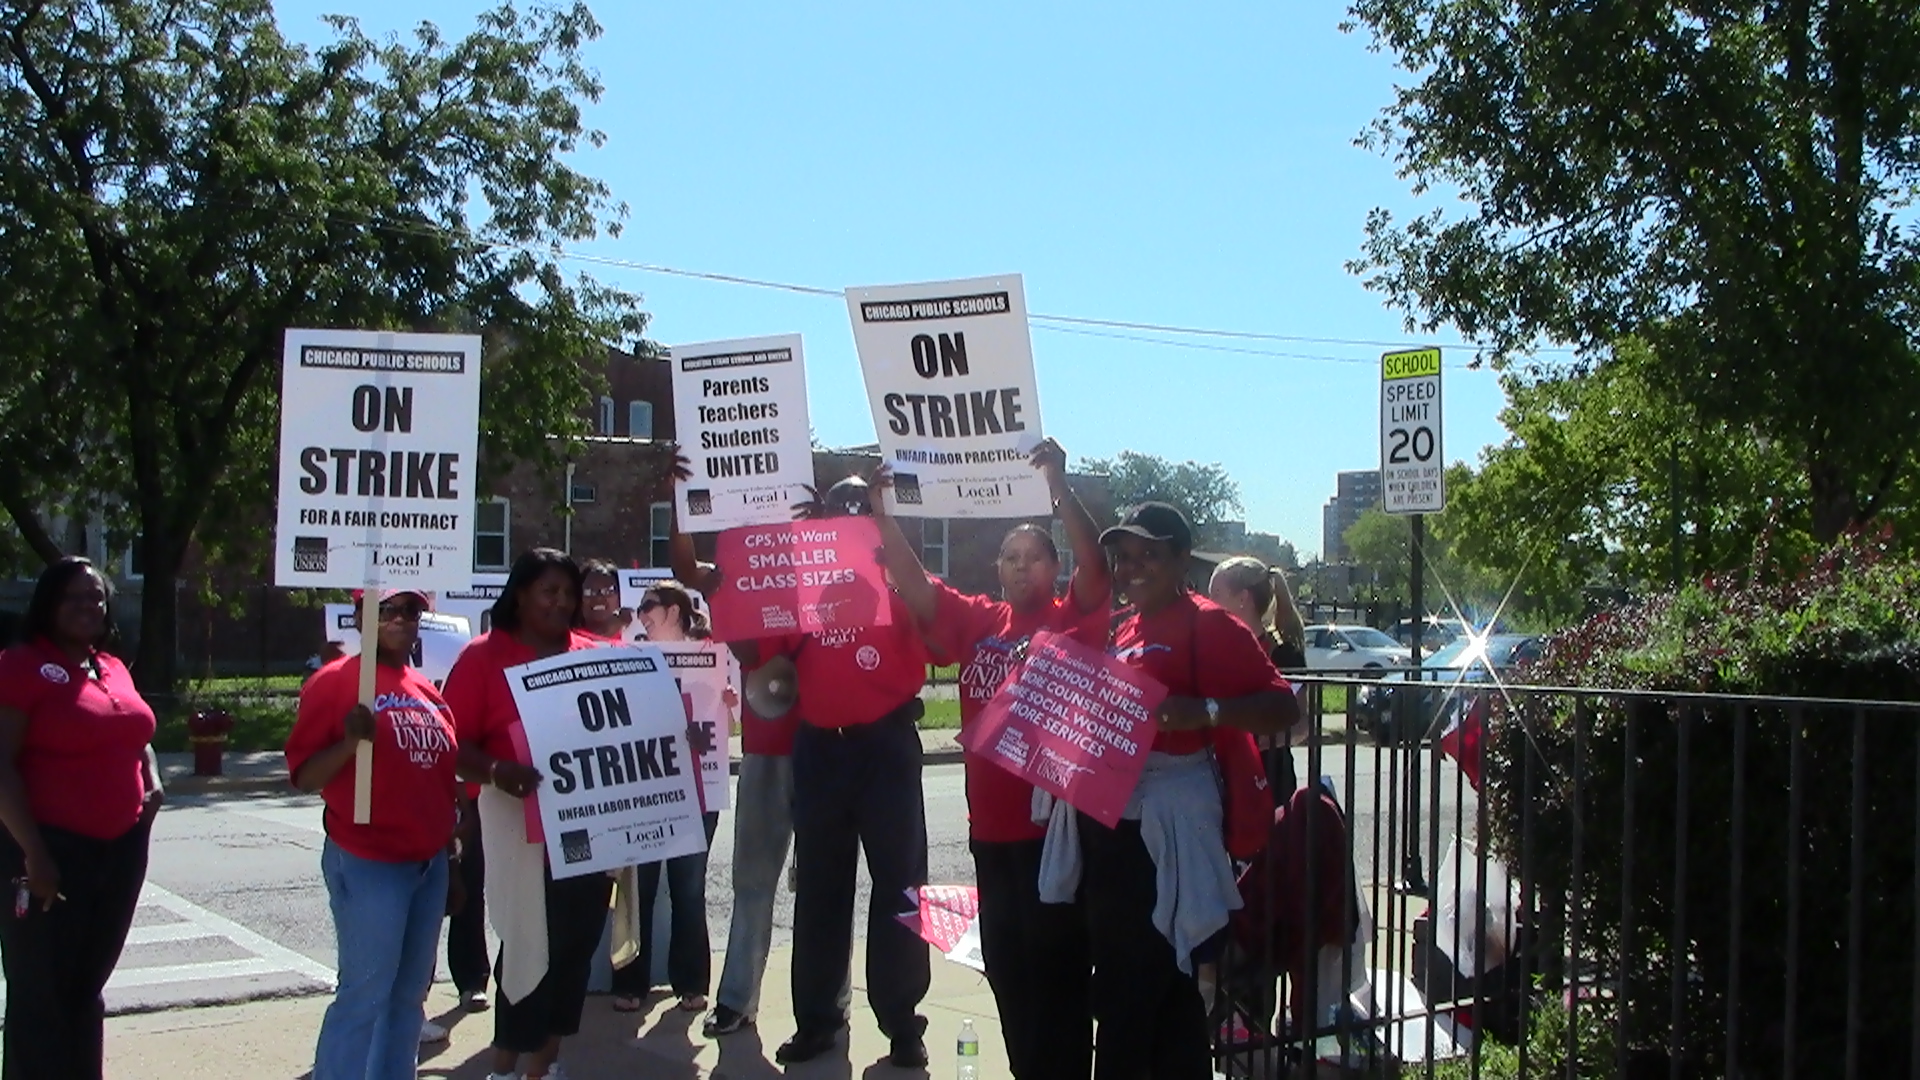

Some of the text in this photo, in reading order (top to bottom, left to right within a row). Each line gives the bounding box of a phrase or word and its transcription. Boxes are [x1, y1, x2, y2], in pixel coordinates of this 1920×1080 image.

[864, 296, 1006, 321] CHICAGO PUBLIC SCHOOLS
[304, 350, 461, 370] CHICAGO PUBLIC SCHOOLS
[911, 332, 970, 380] ON
[1386, 354, 1436, 375] SCHOOL
[703, 376, 769, 397] Parents
[1387, 382, 1435, 402] SPEED
[352, 384, 413, 433] ON
[698, 402, 778, 424] Teachers
[884, 388, 1026, 438] STRIKE
[1392, 404, 1429, 422] LIMIT
[700, 428, 779, 449] Students
[1389, 426, 1434, 464] 20
[706, 452, 779, 478] UNITED
[896, 449, 927, 464] UNFAIR
[930, 452, 963, 465] LABOR
[300, 447, 459, 500] STRIKE
[1386, 467, 1438, 480] ON SCHOOL DAYS
[743, 490, 788, 504] Local 1
[957, 483, 1012, 498] Local 1
[1389, 480, 1437, 492] WHEN CHILDREN
[1393, 493, 1433, 505] ARE PRESENT
[300, 508, 458, 530] FOR A FAIR CONTRACT
[384, 542, 420, 550] Federation
[744, 530, 838, 548] CPS, We Want
[294, 560, 328, 572] UNION
[372, 550, 434, 568] Local 1
[748, 548, 838, 568] SMALLER
[736, 568, 855, 592] CLASS SIZES
[676, 655, 714, 667] SCHOOLS
[526, 672, 574, 688] CHICAGO
[574, 666, 610, 680] PUBLIC
[610, 660, 654, 674] SCHOOLS
[1097, 667, 1144, 698] Deserve:
[1049, 662, 1094, 694] SCHOOL
[1098, 686, 1149, 722] NURSES
[577, 688, 632, 732] ON
[1046, 681, 1134, 733] COUNSELORS
[1008, 700, 1106, 758] MORE SERVICES
[1028, 692, 1070, 720] SOCIAL
[1073, 712, 1138, 756] WORKERS
[394, 726, 450, 752] UNION
[550, 736, 681, 794] STRIKE
[1036, 760, 1070, 790] UNION
[558, 790, 686, 822] UNFAIR LABOR PRACTICES
[626, 824, 676, 844] Local 1
